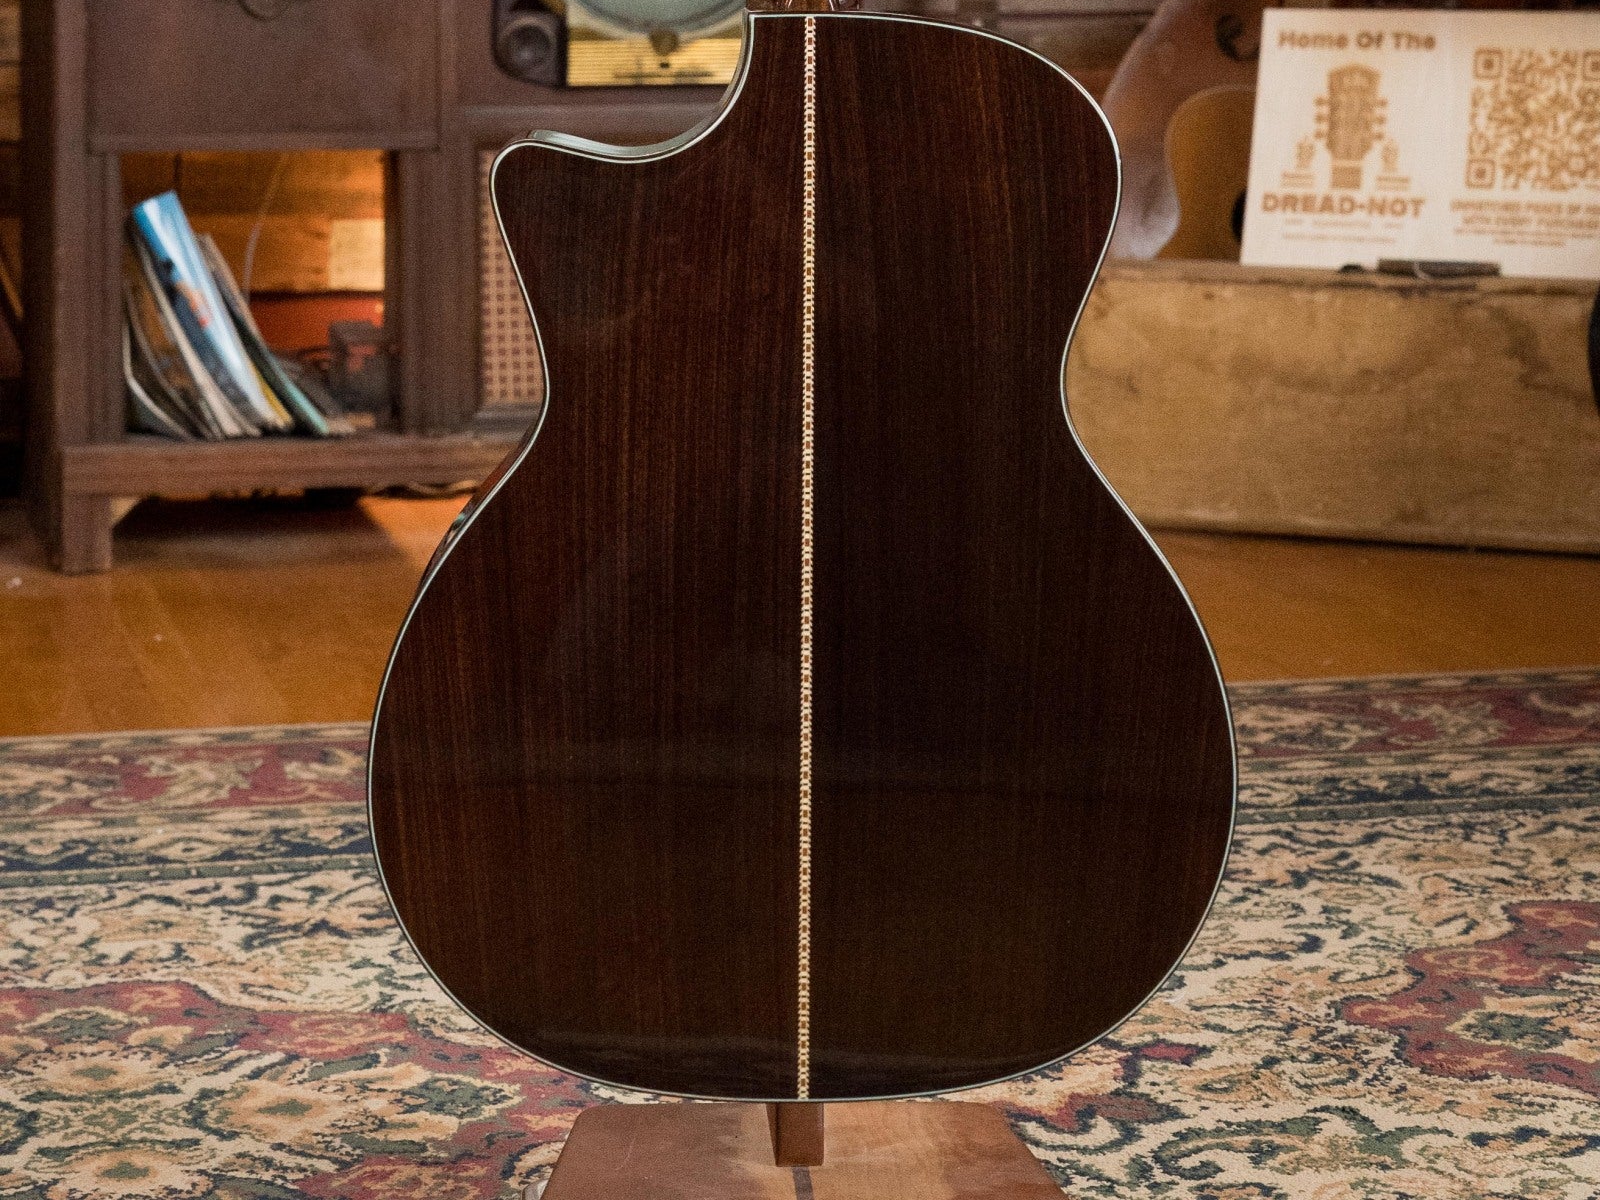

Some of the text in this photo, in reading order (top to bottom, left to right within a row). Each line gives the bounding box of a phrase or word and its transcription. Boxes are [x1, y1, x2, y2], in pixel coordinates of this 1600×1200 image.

[1277, 30, 1437, 50] Home Of The
